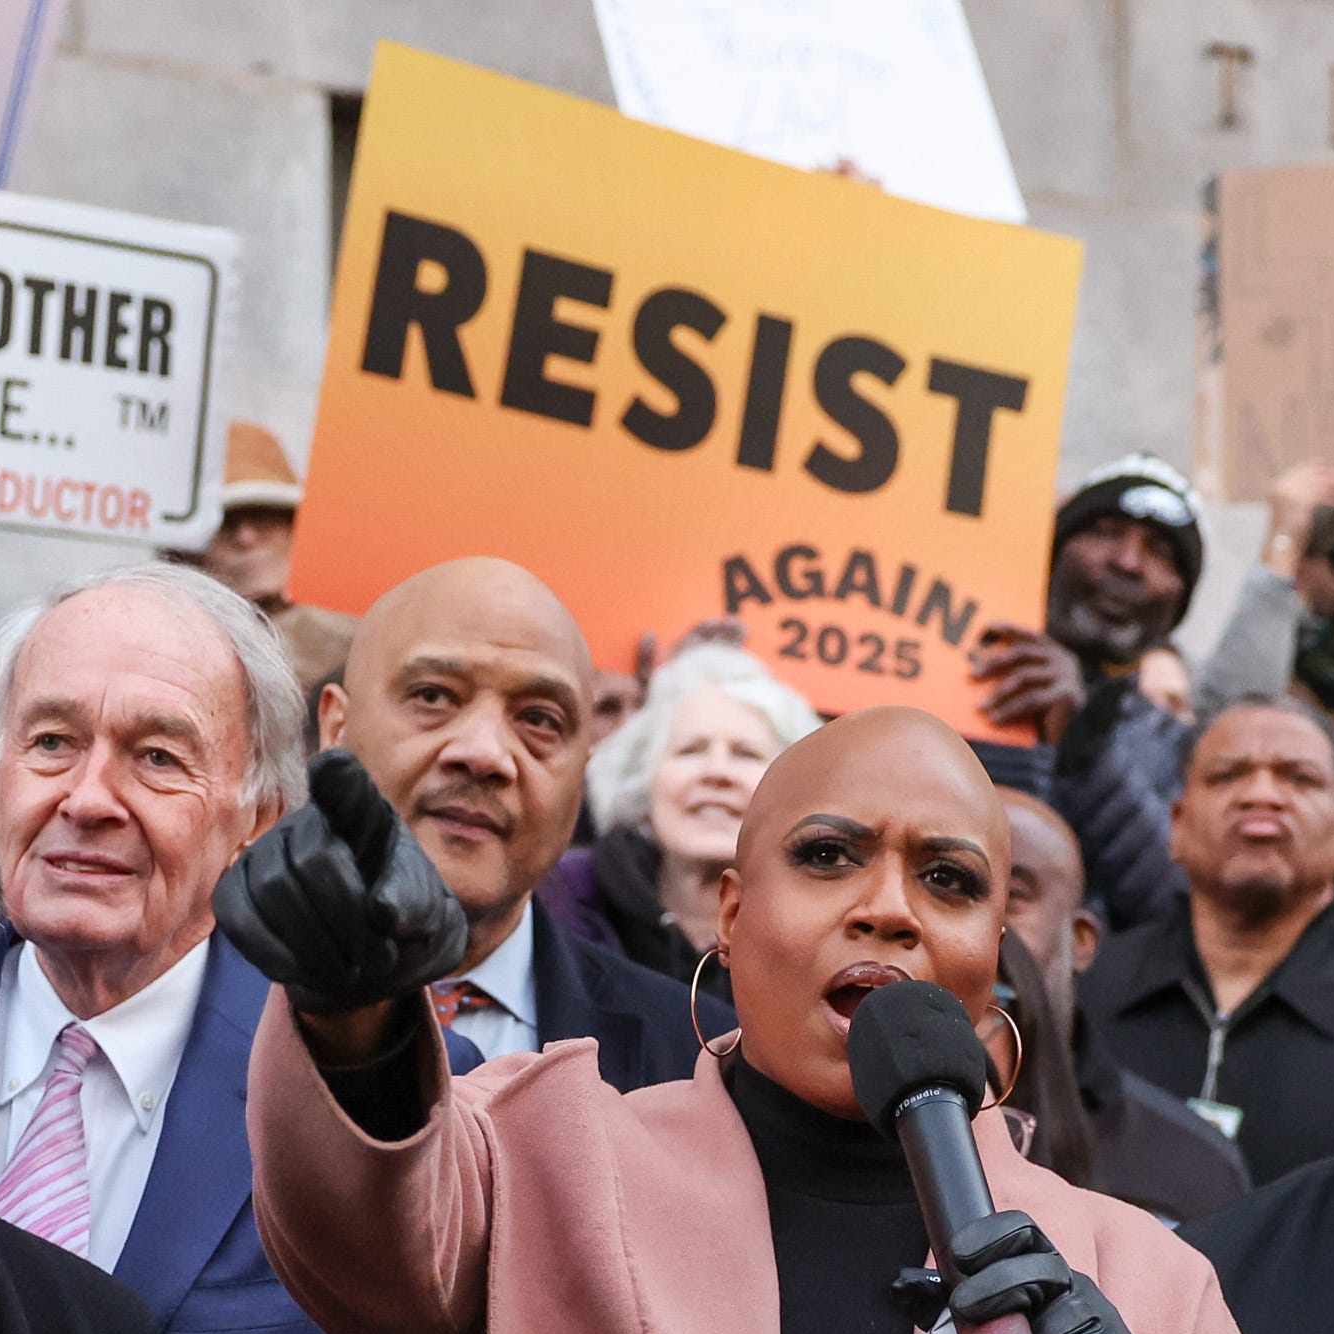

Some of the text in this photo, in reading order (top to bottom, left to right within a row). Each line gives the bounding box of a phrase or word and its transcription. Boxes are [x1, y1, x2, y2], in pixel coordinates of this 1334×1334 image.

[360, 209, 1030, 518] RESIST
[116, 397, 169, 434] TM
[779, 618, 921, 679] 2025
